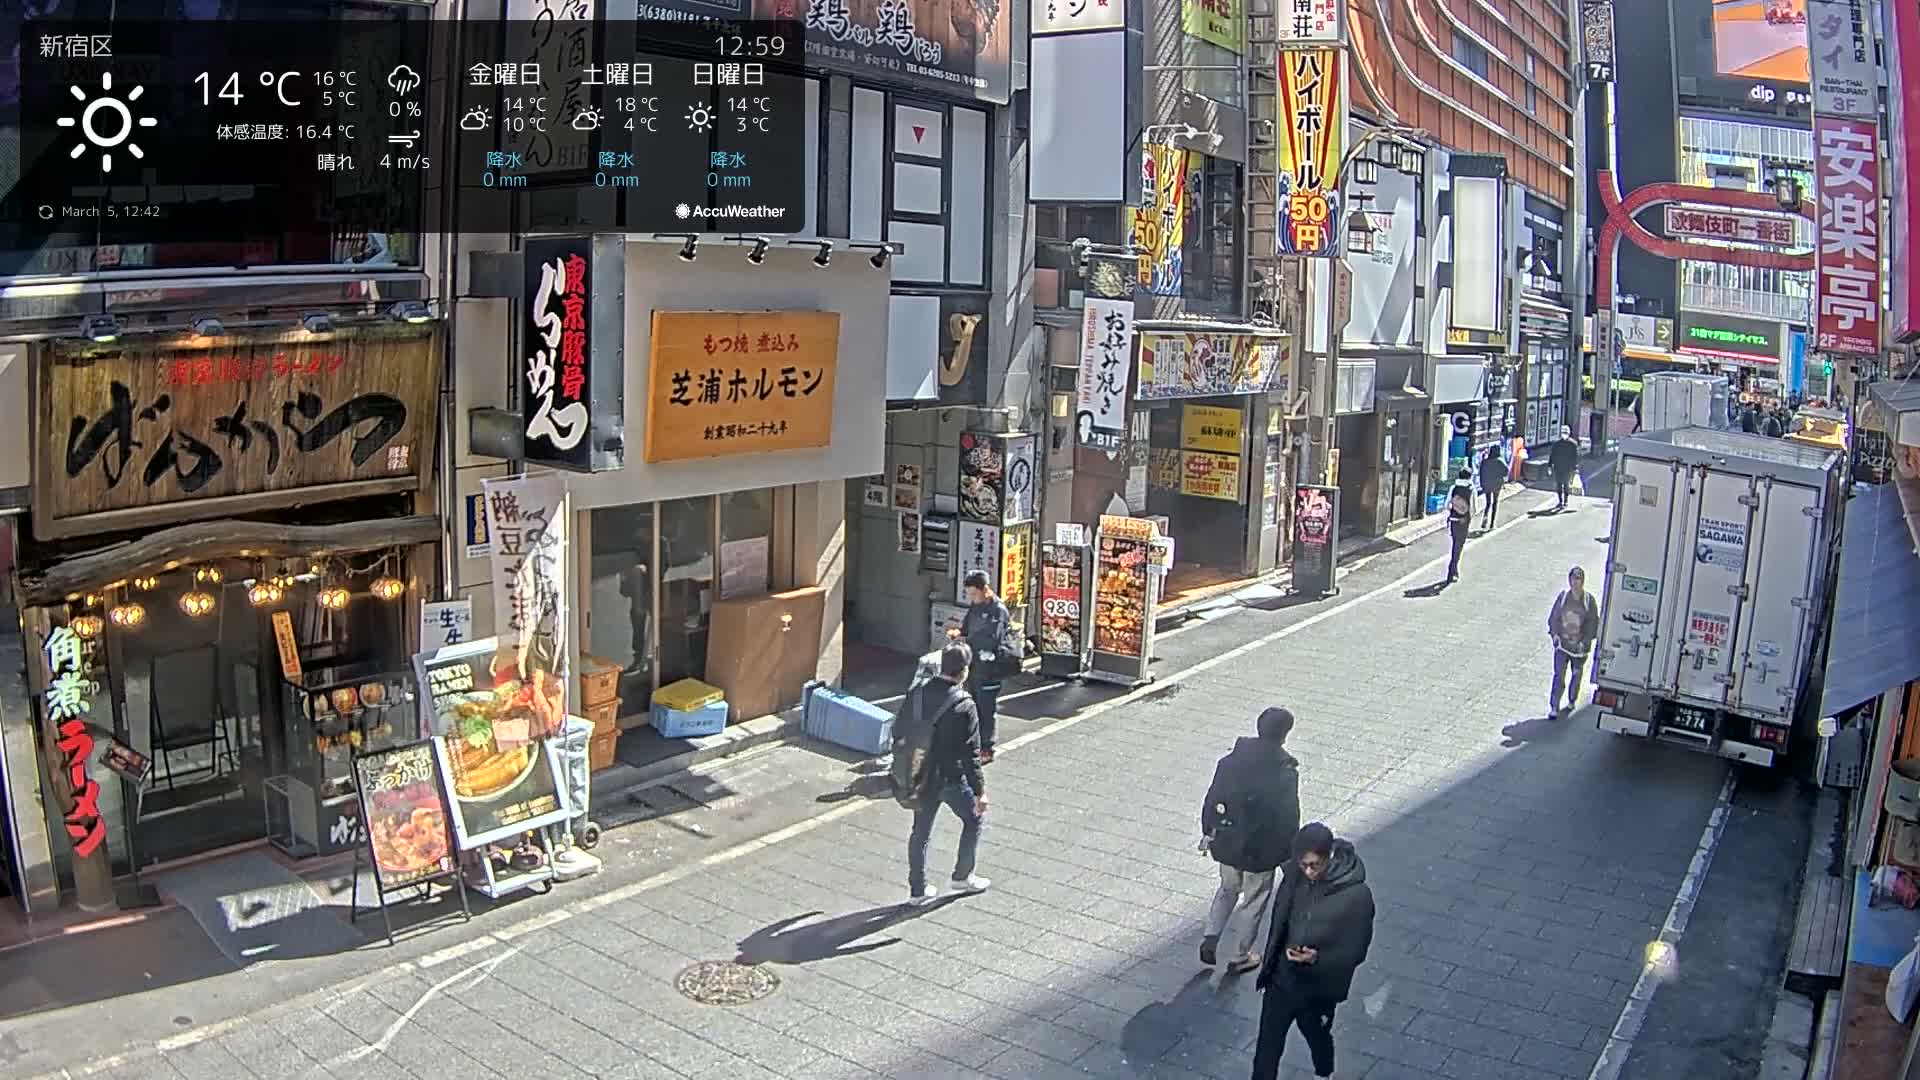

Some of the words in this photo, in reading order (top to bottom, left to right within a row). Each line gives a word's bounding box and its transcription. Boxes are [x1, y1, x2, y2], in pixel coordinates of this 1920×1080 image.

[1818, 13, 1843, 70] タイ
[1590, 63, 1611, 79] 7F
[1750, 84, 1775, 103] dip
[1833, 97, 1857, 112] 3F
[1295, 53, 1323, 191] ハイボール
[1290, 196, 1328, 252] 50円
[1671, 211, 1791, 243] 歌舞伎町一番街
[1818, 126, 1876, 331] 安楽亭
[562, 253, 587, 400] 東京豚骨
[1819, 333, 1837, 347] 2F
[703, 332, 749, 355] もつ焼
[756, 332, 800, 353] 煮込み
[1096, 310, 1127, 416] お好み焼き
[669, 366, 824, 407] 芝浦ホルモン
[66, 379, 407, 493] ばんから
[703, 420, 788, 441] 創業昭和二十九年
[1700, 529, 1744, 546] SAGAWA
[428, 663, 473, 684] TOKYO
[431, 675, 473, 696] RAMEN
